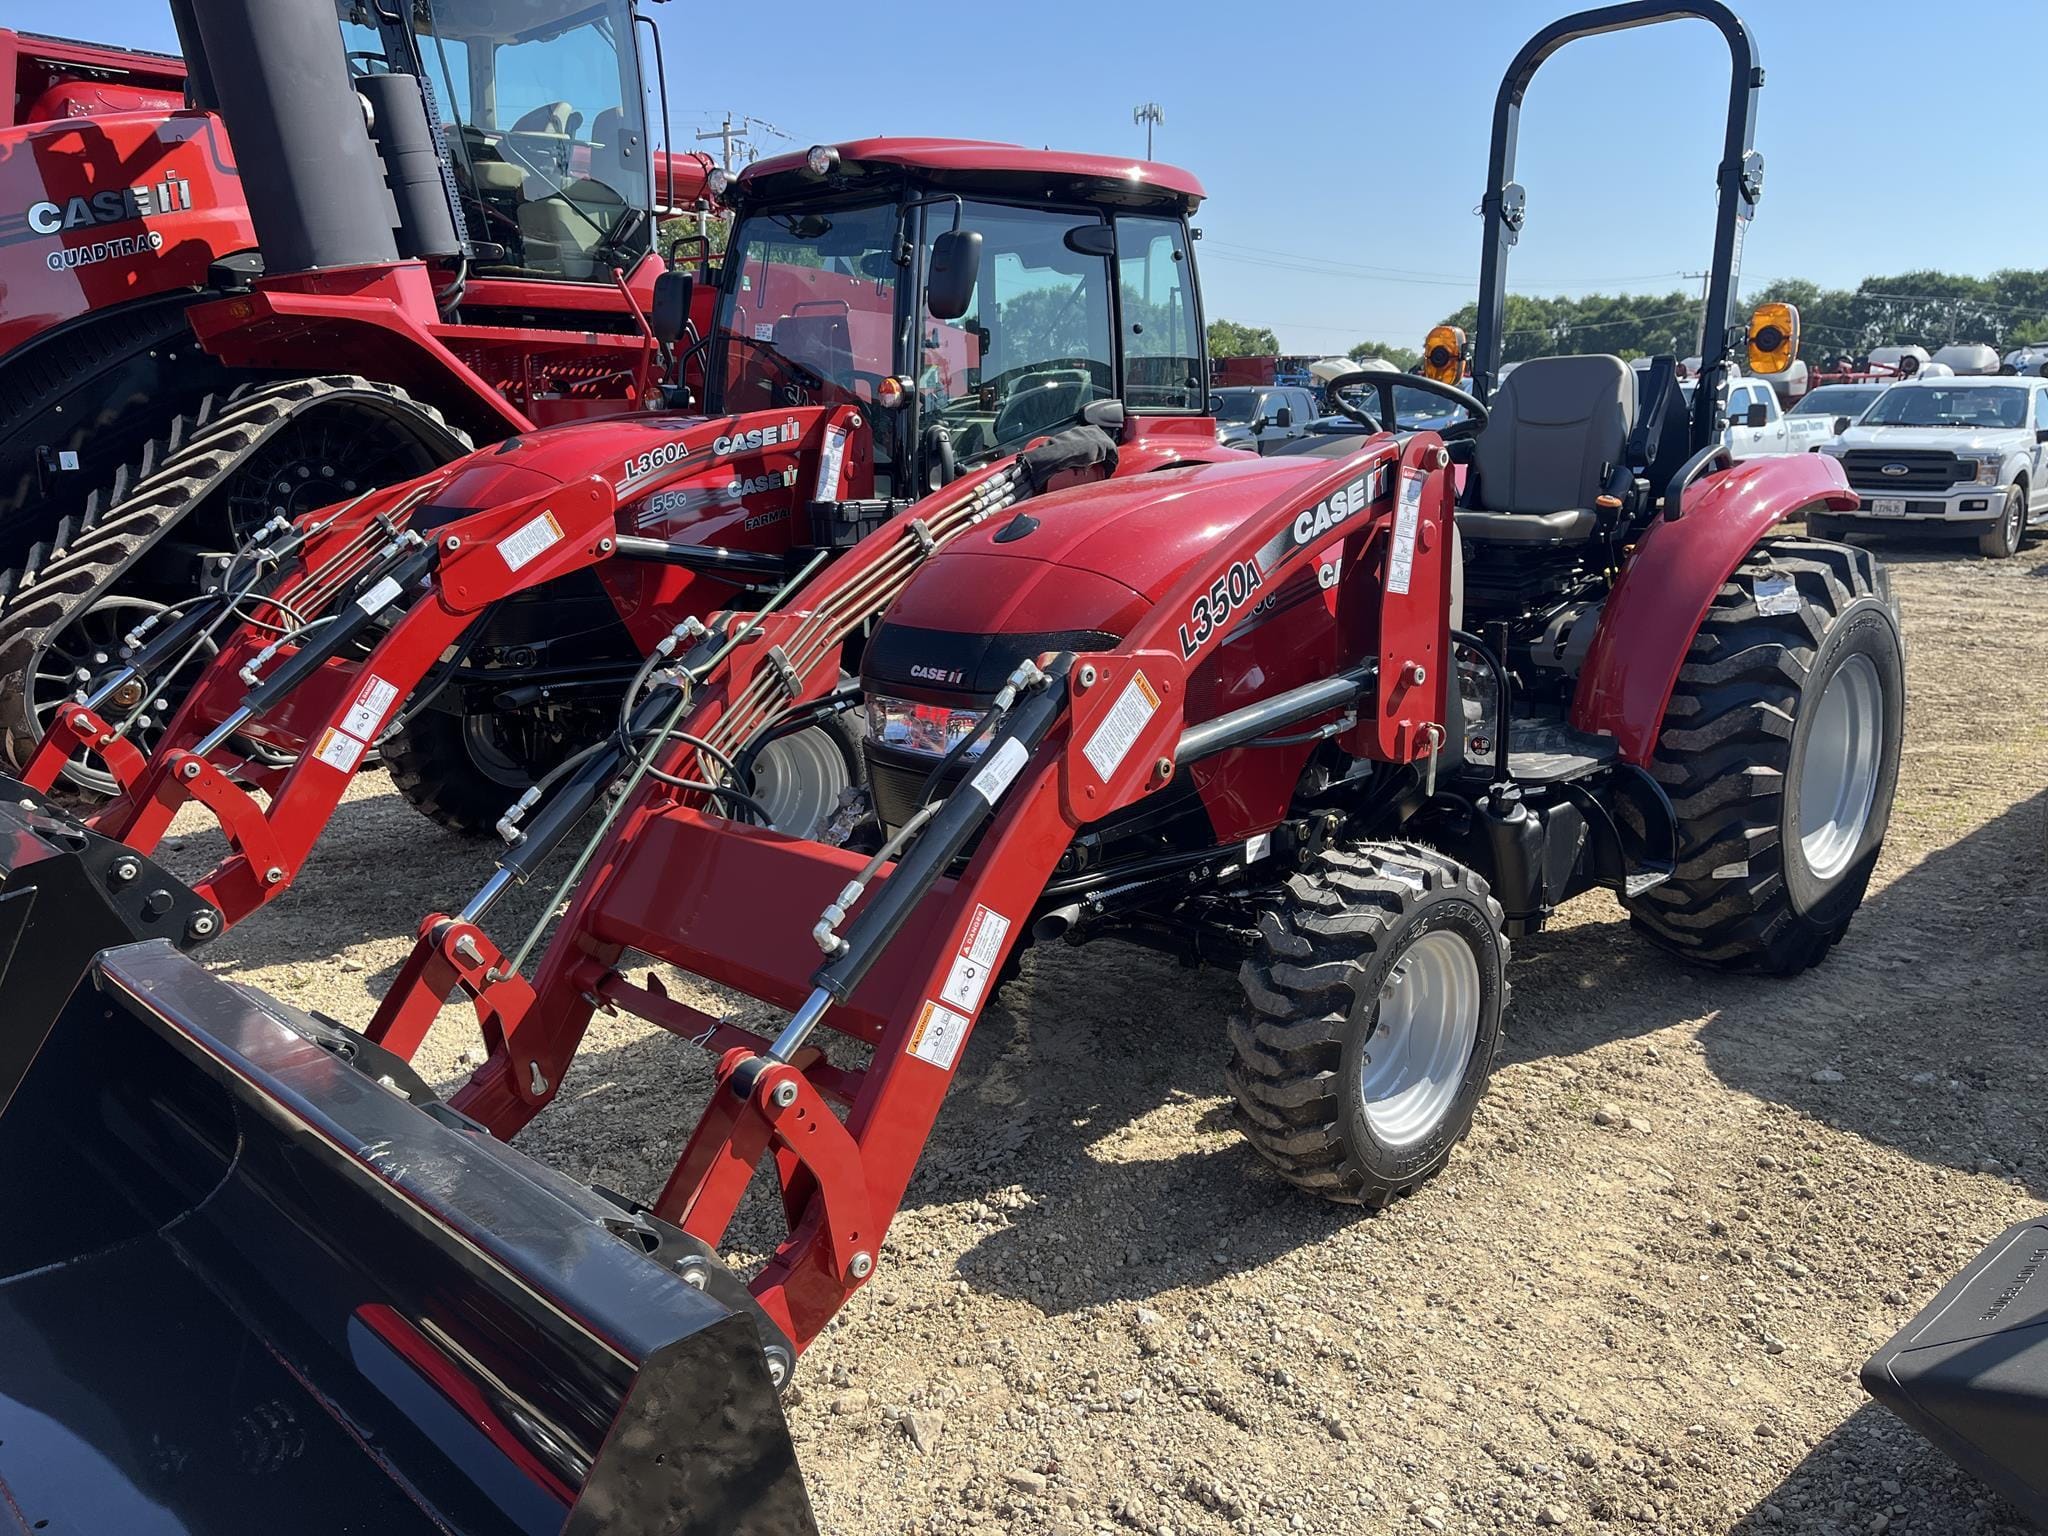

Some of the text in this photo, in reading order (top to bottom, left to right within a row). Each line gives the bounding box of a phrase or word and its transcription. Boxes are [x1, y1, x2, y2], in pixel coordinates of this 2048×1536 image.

[28, 186, 152, 234] CASE
[47, 231, 163, 271] QUADTRAC
[712, 426, 778, 455] CASE
[624, 442, 689, 481] L360A
[727, 473, 781, 498] CASE
[1294, 479, 1365, 544] CASE
[1178, 559, 1262, 661] L350A
[910, 665, 947, 681] CASE
[966, 911, 984, 945] DANGER
[916, 1008, 932, 1041] WARNING
[2012, 1264, 2040, 1284] NOT
